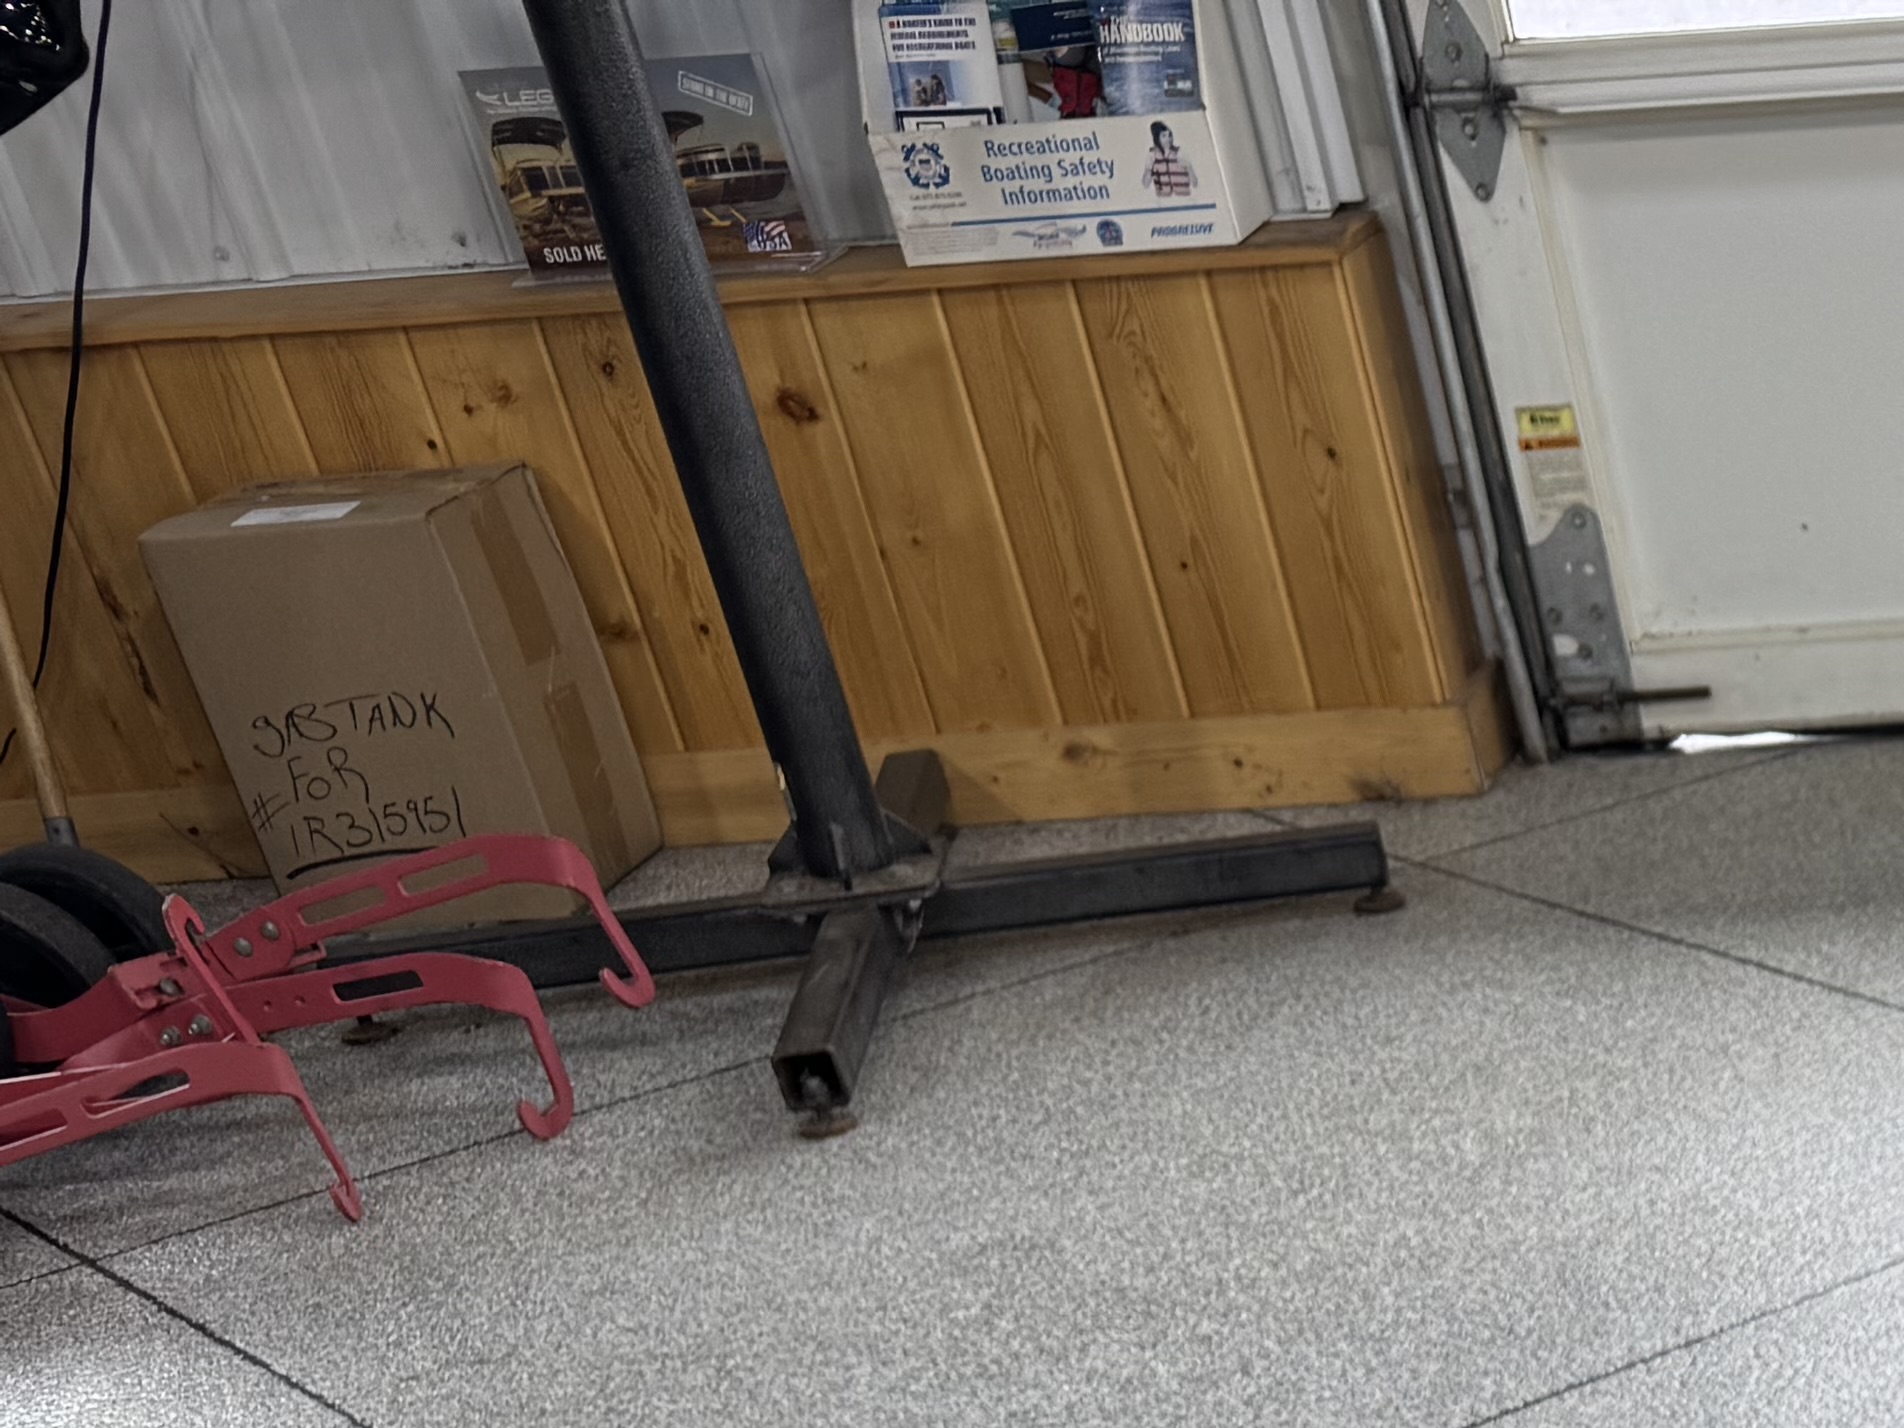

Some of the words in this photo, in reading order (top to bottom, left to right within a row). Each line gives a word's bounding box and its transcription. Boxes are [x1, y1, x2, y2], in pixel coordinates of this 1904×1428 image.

[1100, 22, 1185, 44] HANDBOOK
[503, 89, 555, 108] LEG
[984, 130, 1100, 158] Recreational
[981, 162, 1052, 184] Boating
[1060, 157, 1114, 180] Safety
[1001, 182, 1109, 207] Information
[544, 244, 582, 264] SOLD
[585, 244, 606, 262] HE
[324, 691, 455, 739] TANK
